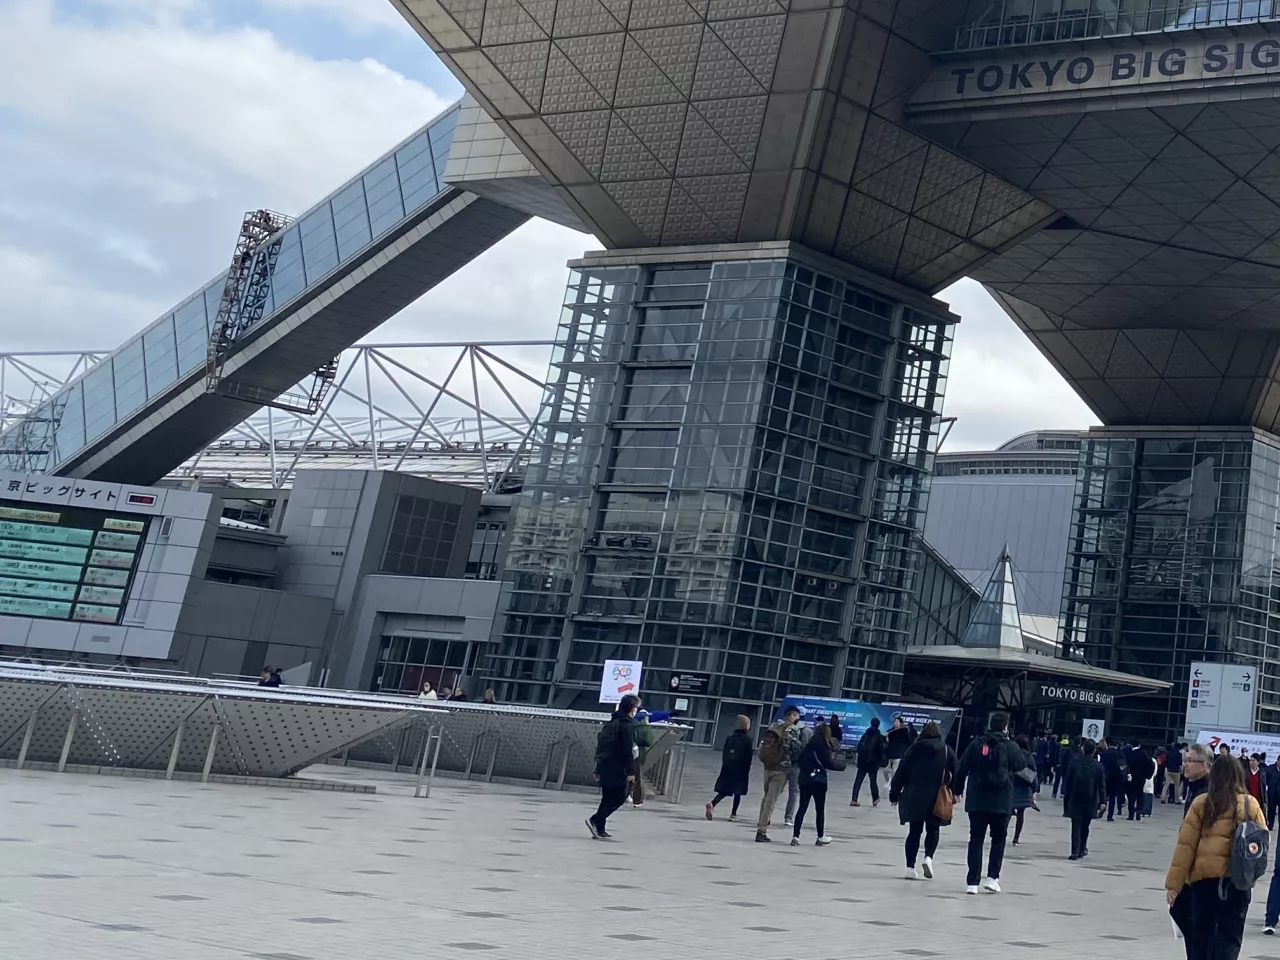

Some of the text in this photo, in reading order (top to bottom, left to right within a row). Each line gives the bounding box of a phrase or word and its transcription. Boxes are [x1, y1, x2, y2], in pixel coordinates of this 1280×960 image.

[950, 56, 1095, 94] TOKYO
[1111, 47, 1187, 81] BIG
[0, 479, 118, 502] 京ビッグサイト
[1041, 685, 1115, 705] TOKYO BIG SIGHT
